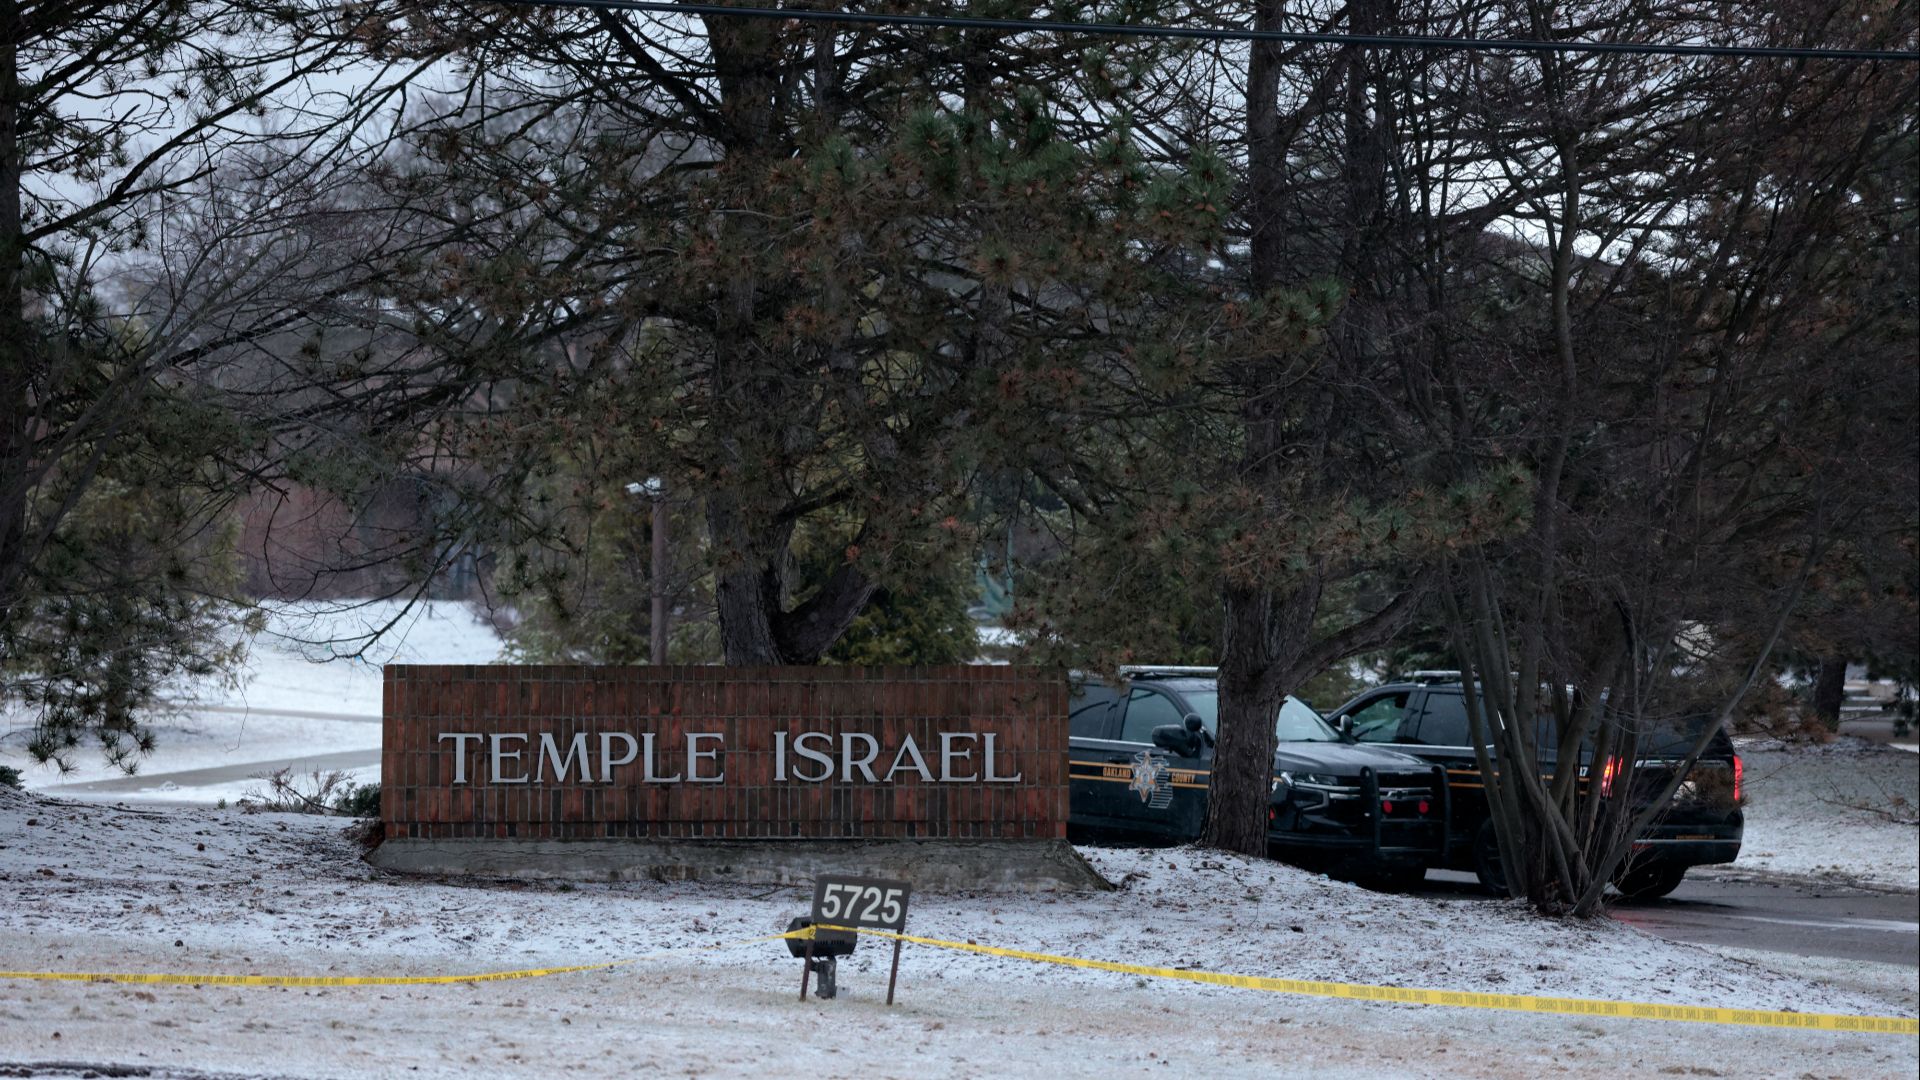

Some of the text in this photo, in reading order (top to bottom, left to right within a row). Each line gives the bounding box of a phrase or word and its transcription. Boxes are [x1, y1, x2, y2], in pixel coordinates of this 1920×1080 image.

[438, 730, 1022, 784] TEMPLE ISRAEL
[1103, 767, 1196, 784] OAKLAND COUNTY
[821, 883, 903, 924] 5725
